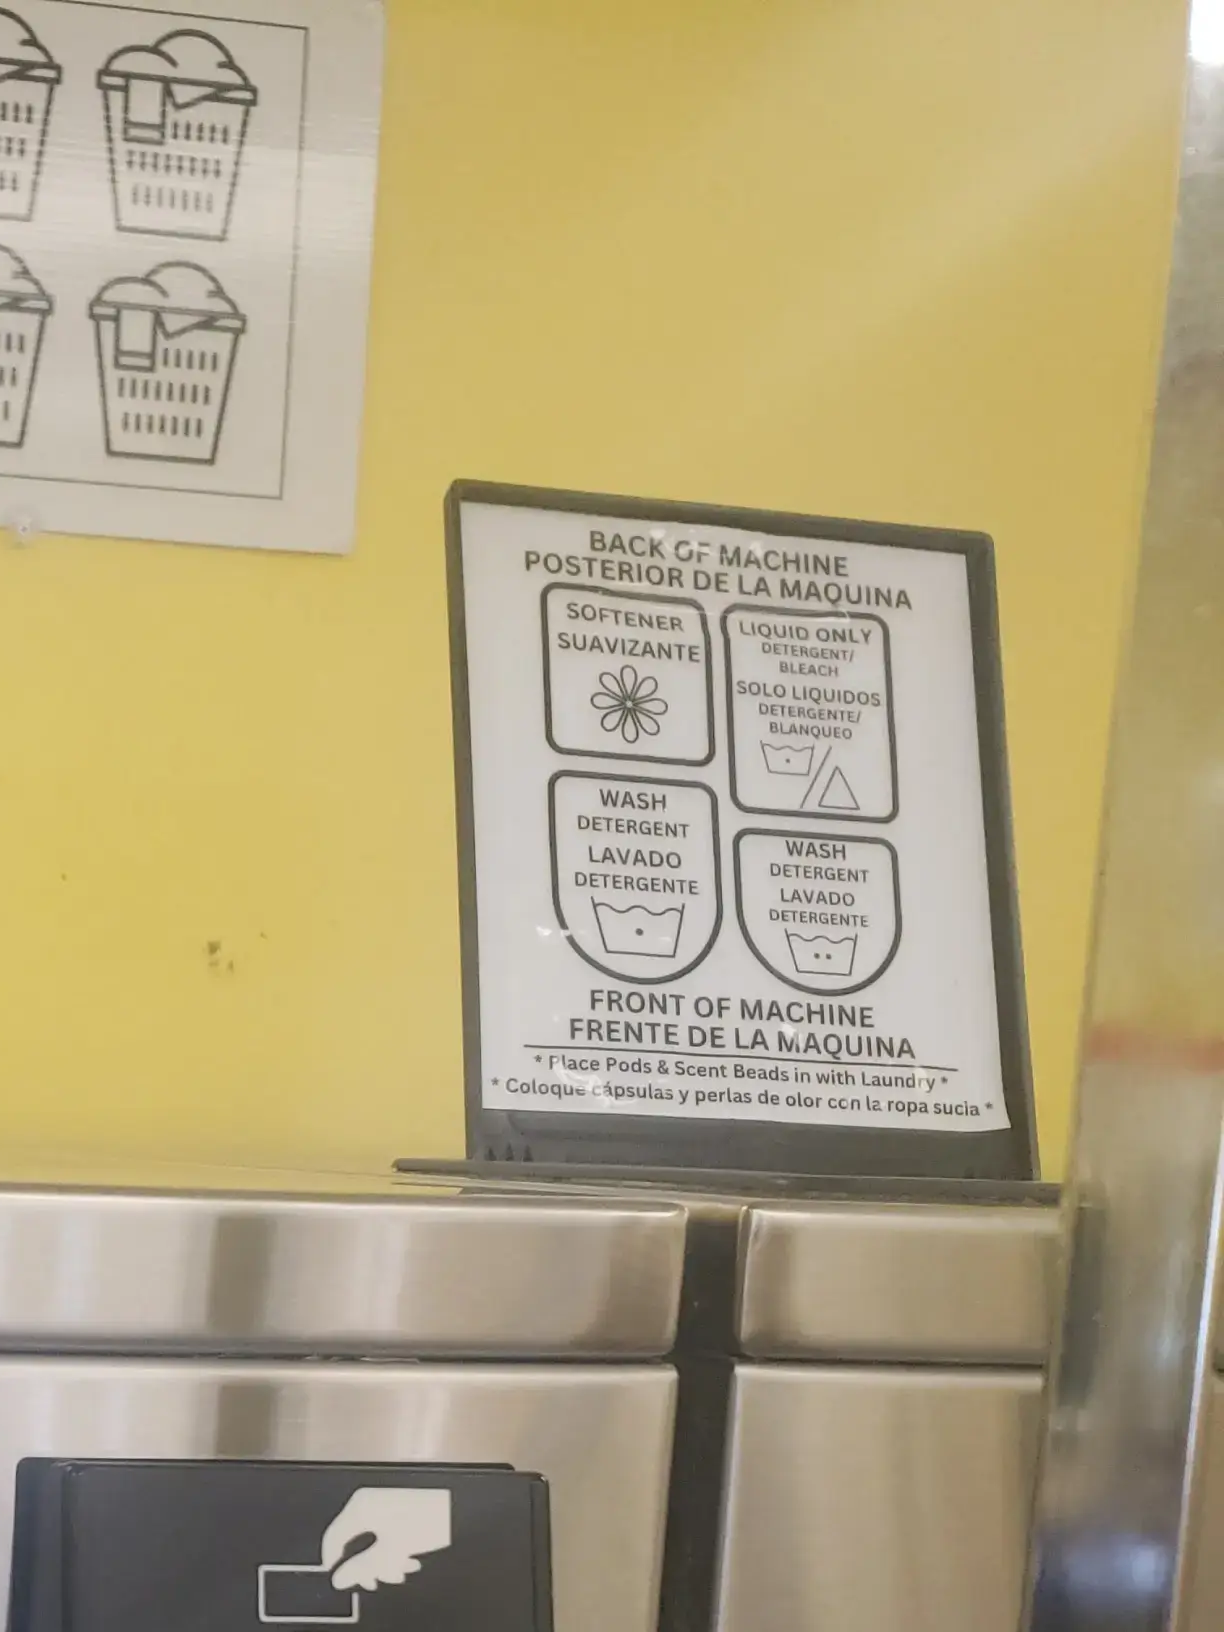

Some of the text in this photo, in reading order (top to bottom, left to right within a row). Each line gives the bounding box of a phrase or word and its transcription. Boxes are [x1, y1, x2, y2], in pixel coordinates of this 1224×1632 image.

[589, 530, 849, 578] BACK OF MACHINE
[524, 550, 913, 611] POSTERIOR DE LA MAQUINA
[566, 602, 684, 632] SOFTENER
[739, 620, 872, 645] LIQUID ONLY
[557, 632, 701, 664] SUAVIZANTE
[761, 642, 854, 663] DETERGENT/
[779, 661, 839, 678] BLEACH
[736, 679, 881, 708] SOLO LIQUIDOS
[758, 702, 861, 724] DETERGENTE/
[769, 720, 852, 741] BLANQUEO
[599, 789, 667, 812] WASH
[577, 815, 690, 839] DETERGENT
[588, 846, 682, 870] LAVADO
[785, 839, 847, 861] WASH
[574, 871, 699, 896] DETERGENTE
[770, 862, 869, 884] DETERGENT
[780, 888, 855, 907] LAVADO
[769, 908, 869, 929] DETERGENTE
[589, 989, 875, 1029] FRONT OF MACHINE
[569, 1018, 915, 1061] FRENTE DE LA MAQUINA
[549, 1054, 600, 1073] Place
[606, 1056, 652, 1076] Pods
[657, 1059, 669, 1075] &
[675, 1060, 728, 1079] Scent
[733, 1062, 790, 1083] Beads
[794, 1067, 811, 1083] in
[815, 1067, 856, 1086] with
[862, 1071, 936, 1092] Laundry
[506, 1077, 587, 1100] Coloque
[592, 1079, 673, 1103] cápsulas
[695, 1085, 753, 1108] perlas
[758, 1087, 781, 1105] de
[785, 1090, 822, 1109] olor
[827, 1096, 861, 1111] con
[867, 1093, 882, 1112] la
[887, 1101, 930, 1117] ropa
[934, 1098, 980, 1116] sucia
